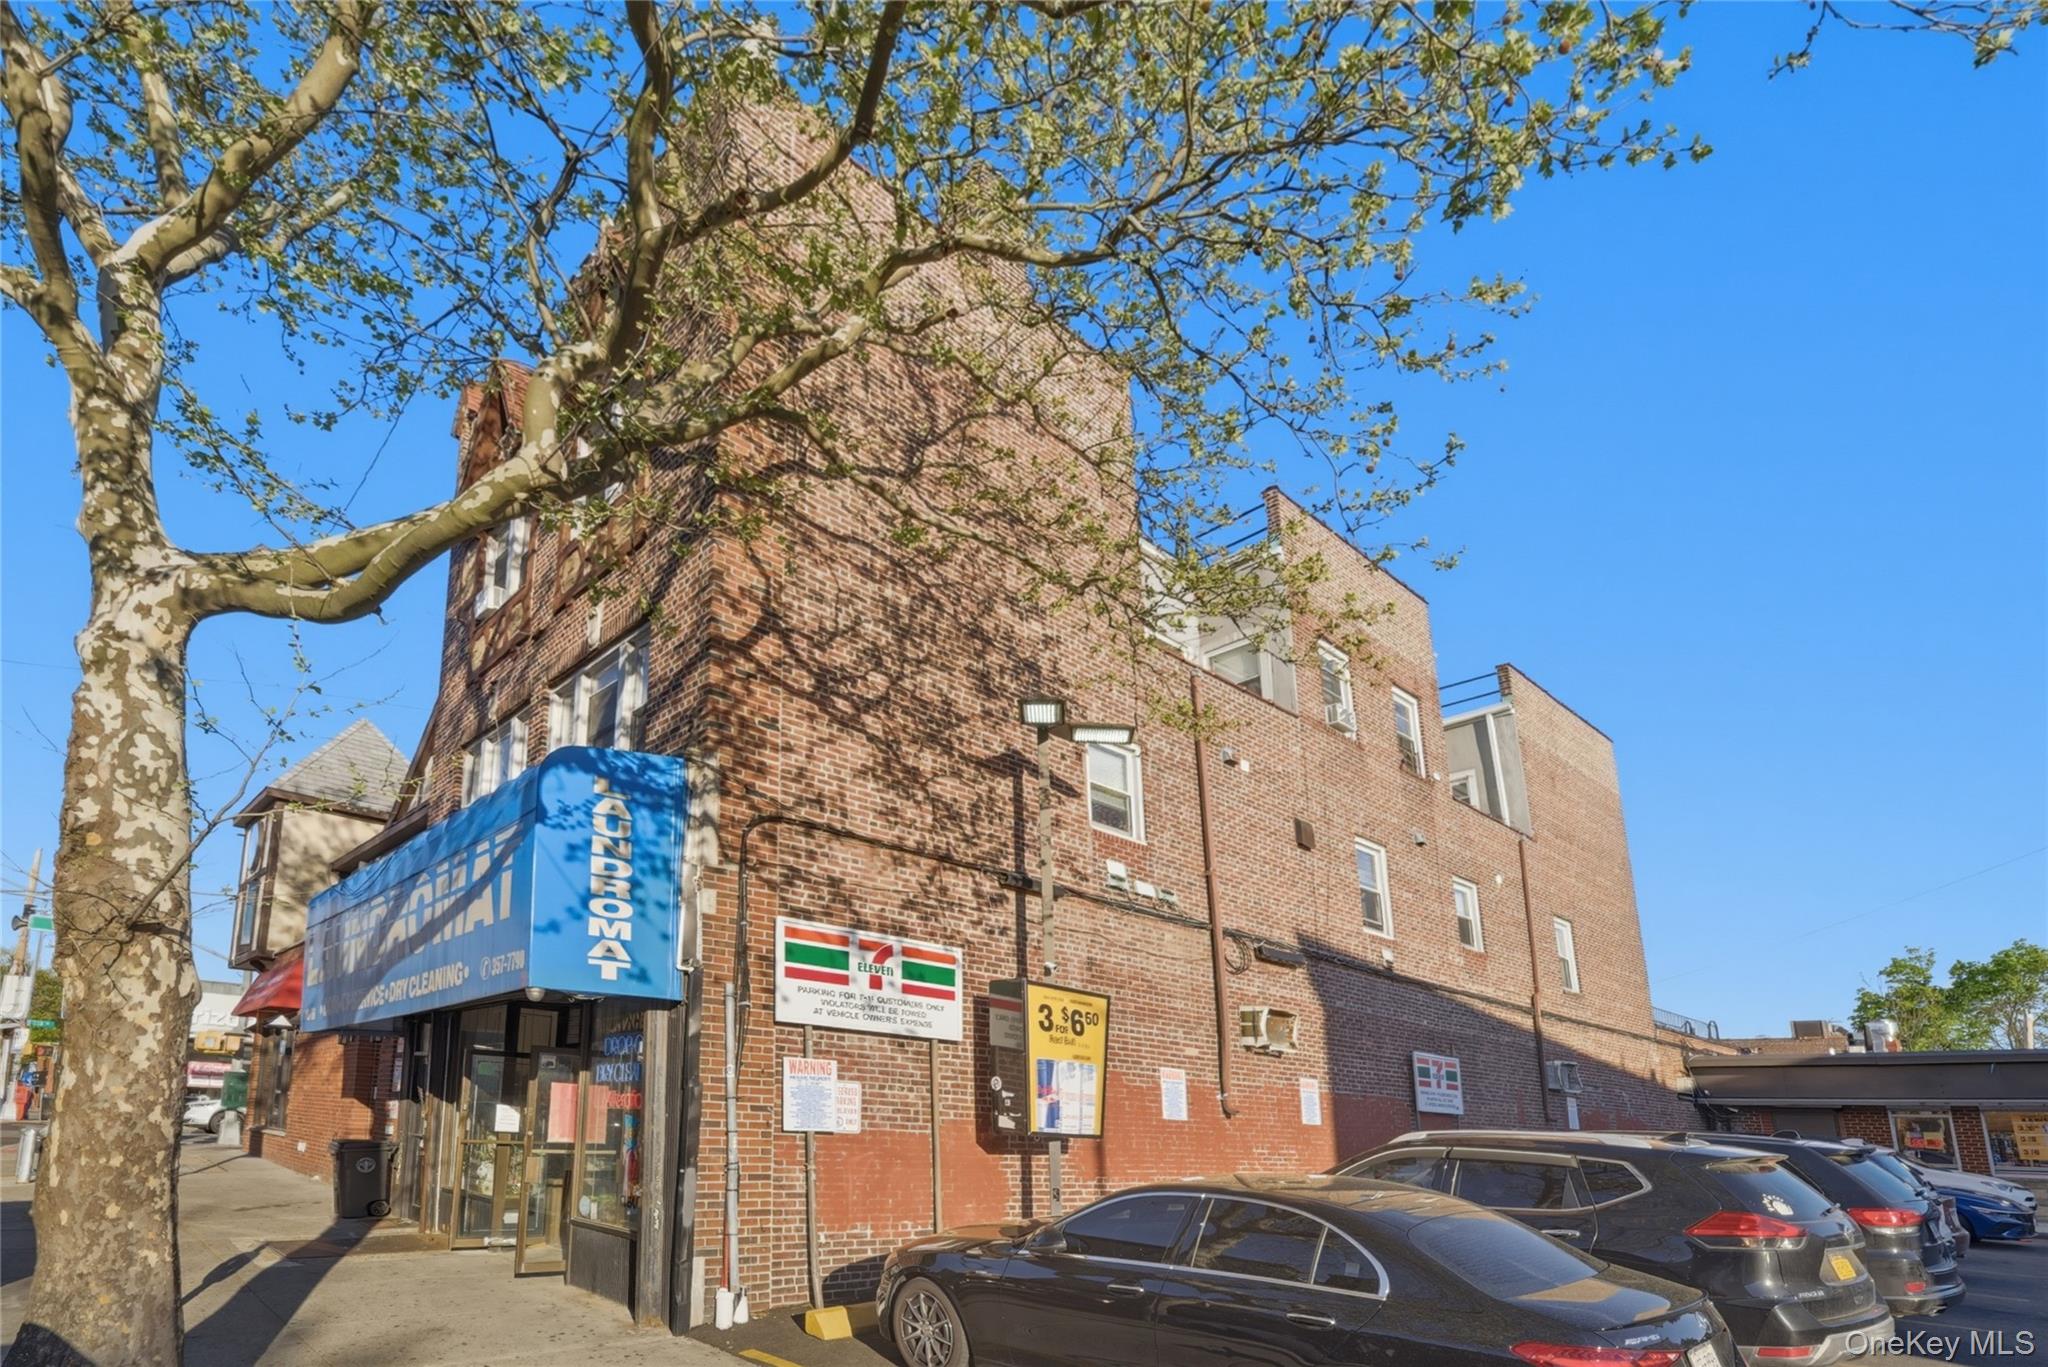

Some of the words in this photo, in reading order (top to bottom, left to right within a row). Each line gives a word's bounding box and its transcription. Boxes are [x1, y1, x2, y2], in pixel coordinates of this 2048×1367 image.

[587, 776, 633, 980] LAUNDROMAT
[305, 825, 521, 987] LNDROMAT
[388, 978, 410, 1003] DRY
[409, 961, 464, 998] CLEANING
[797, 986, 836, 998] PARKING
[839, 991, 856, 1000] FOR
[877, 996, 924, 1010] CUSTOMERS
[926, 1003, 945, 1012] ONLY
[820, 999, 866, 1012] VIOLATORS
[867, 1003, 885, 1014] WILL
[888, 1007, 899, 1016] BE
[901, 1009, 927, 1018] TOWED
[812, 1008, 823, 1016] AT
[826, 1009, 859, 1020] VEHICLE
[1038, 1004, 1054, 1032] 3
[1055, 1024, 1069, 1034] FOR
[788, 1059, 832, 1076] WARNING
